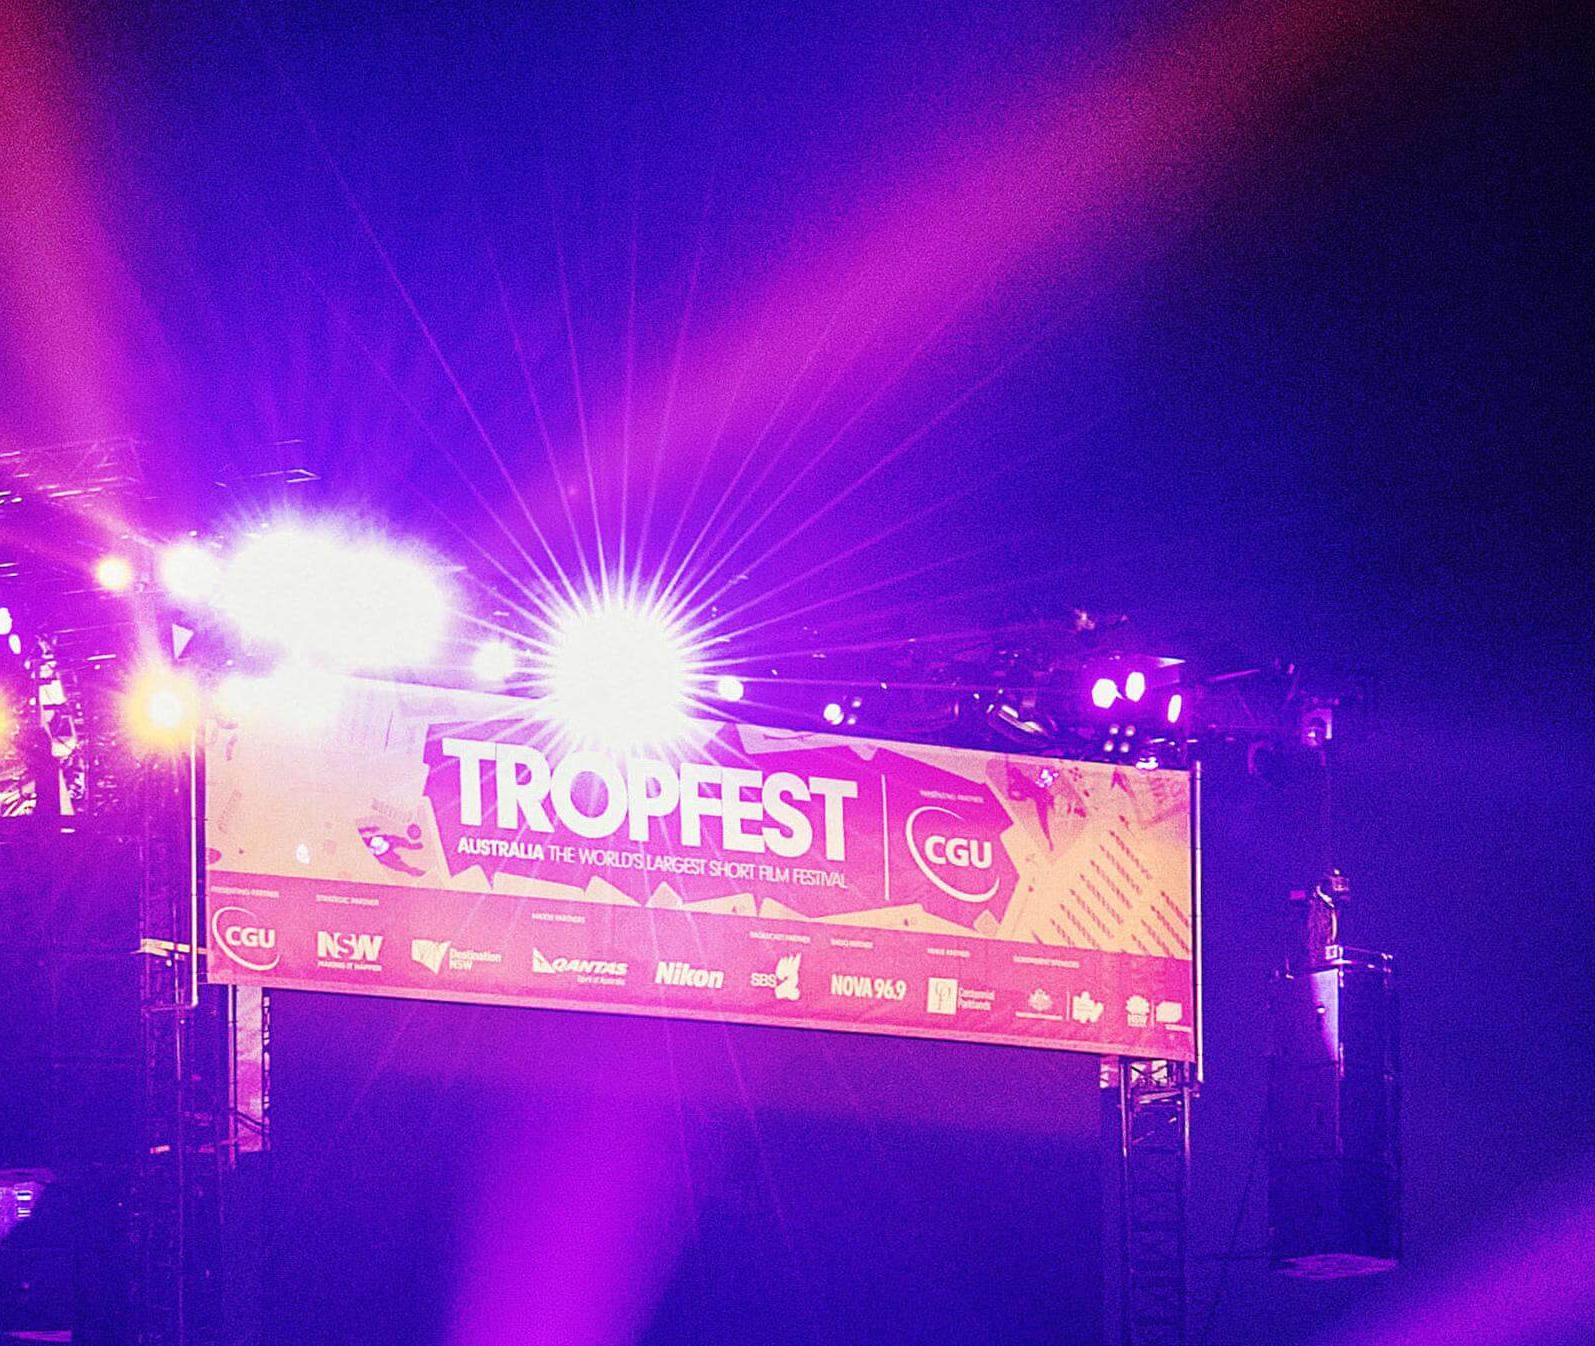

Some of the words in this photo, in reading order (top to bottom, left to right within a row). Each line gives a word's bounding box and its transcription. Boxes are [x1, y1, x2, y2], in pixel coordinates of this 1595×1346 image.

[442, 737, 858, 862] TROPFEST
[457, 837, 544, 860] AUSTRALIA
[548, 845, 575, 863] THE
[647, 855, 706, 875] LARGEST
[709, 859, 754, 880] SHORT
[758, 865, 790, 882] FILM
[793, 868, 847, 888] FESTIVAL
[924, 835, 992, 869] CGU
[225, 926, 275, 948] CGU
[317, 931, 383, 961] NSW
[450, 948, 501, 963] Destination
[450, 960, 473, 970] NSW
[553, 957, 628, 975] QANTAS
[655, 961, 724, 989] Nikon
[750, 973, 777, 988] SBS
[831, 974, 872, 998] NOVA
[874, 979, 907, 1001] 96.9
